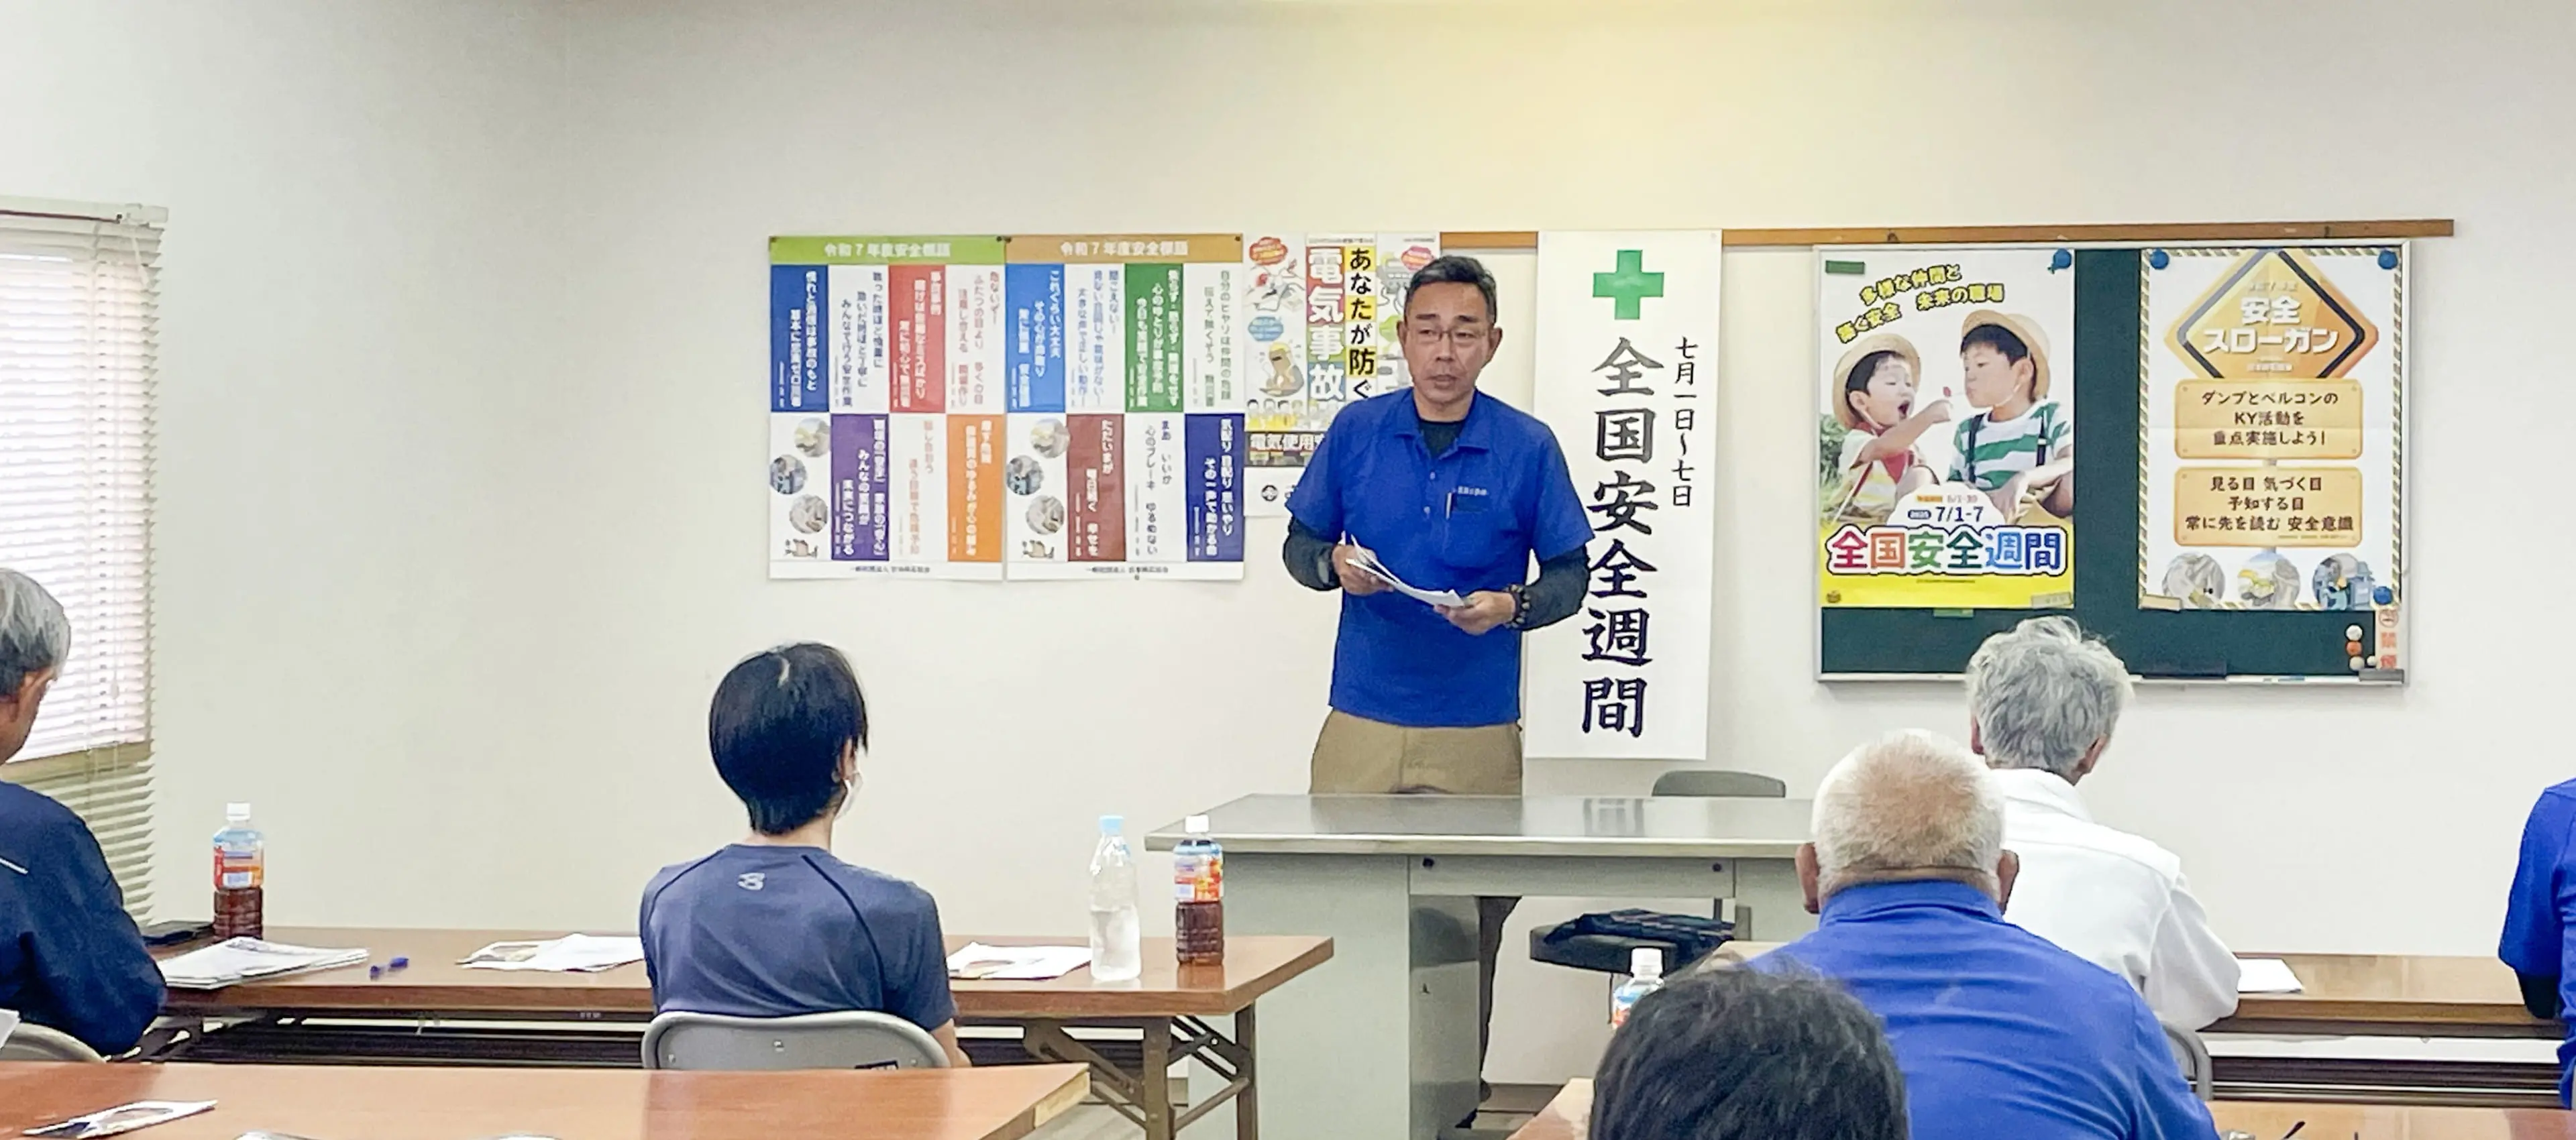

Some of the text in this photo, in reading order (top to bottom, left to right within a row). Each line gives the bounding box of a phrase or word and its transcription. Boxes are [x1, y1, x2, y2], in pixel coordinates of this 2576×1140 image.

[1860, 264, 1963, 306] 多様な仲間と
[1916, 282, 2005, 311] 未来の職場
[1308, 247, 1345, 401] 電気事故
[1349, 248, 1376, 399] あなたが防ぐ
[2241, 295, 2302, 325] 安全
[2204, 327, 2340, 354] スローガン
[2201, 390, 2339, 405] ダンプとベルコンの
[2234, 412, 2305, 426] KY活動を
[2210, 476, 2322, 492] 見る目 気づく目
[1935, 506, 1984, 522] 7/1-7
[2227, 496, 2305, 511] 予知する目
[1580, 336, 1665, 738] 全国安全週間
[2185, 515, 2354, 531] 常に先を読む 安全意識
[1831, 530, 2061, 571] 全国安全週間
